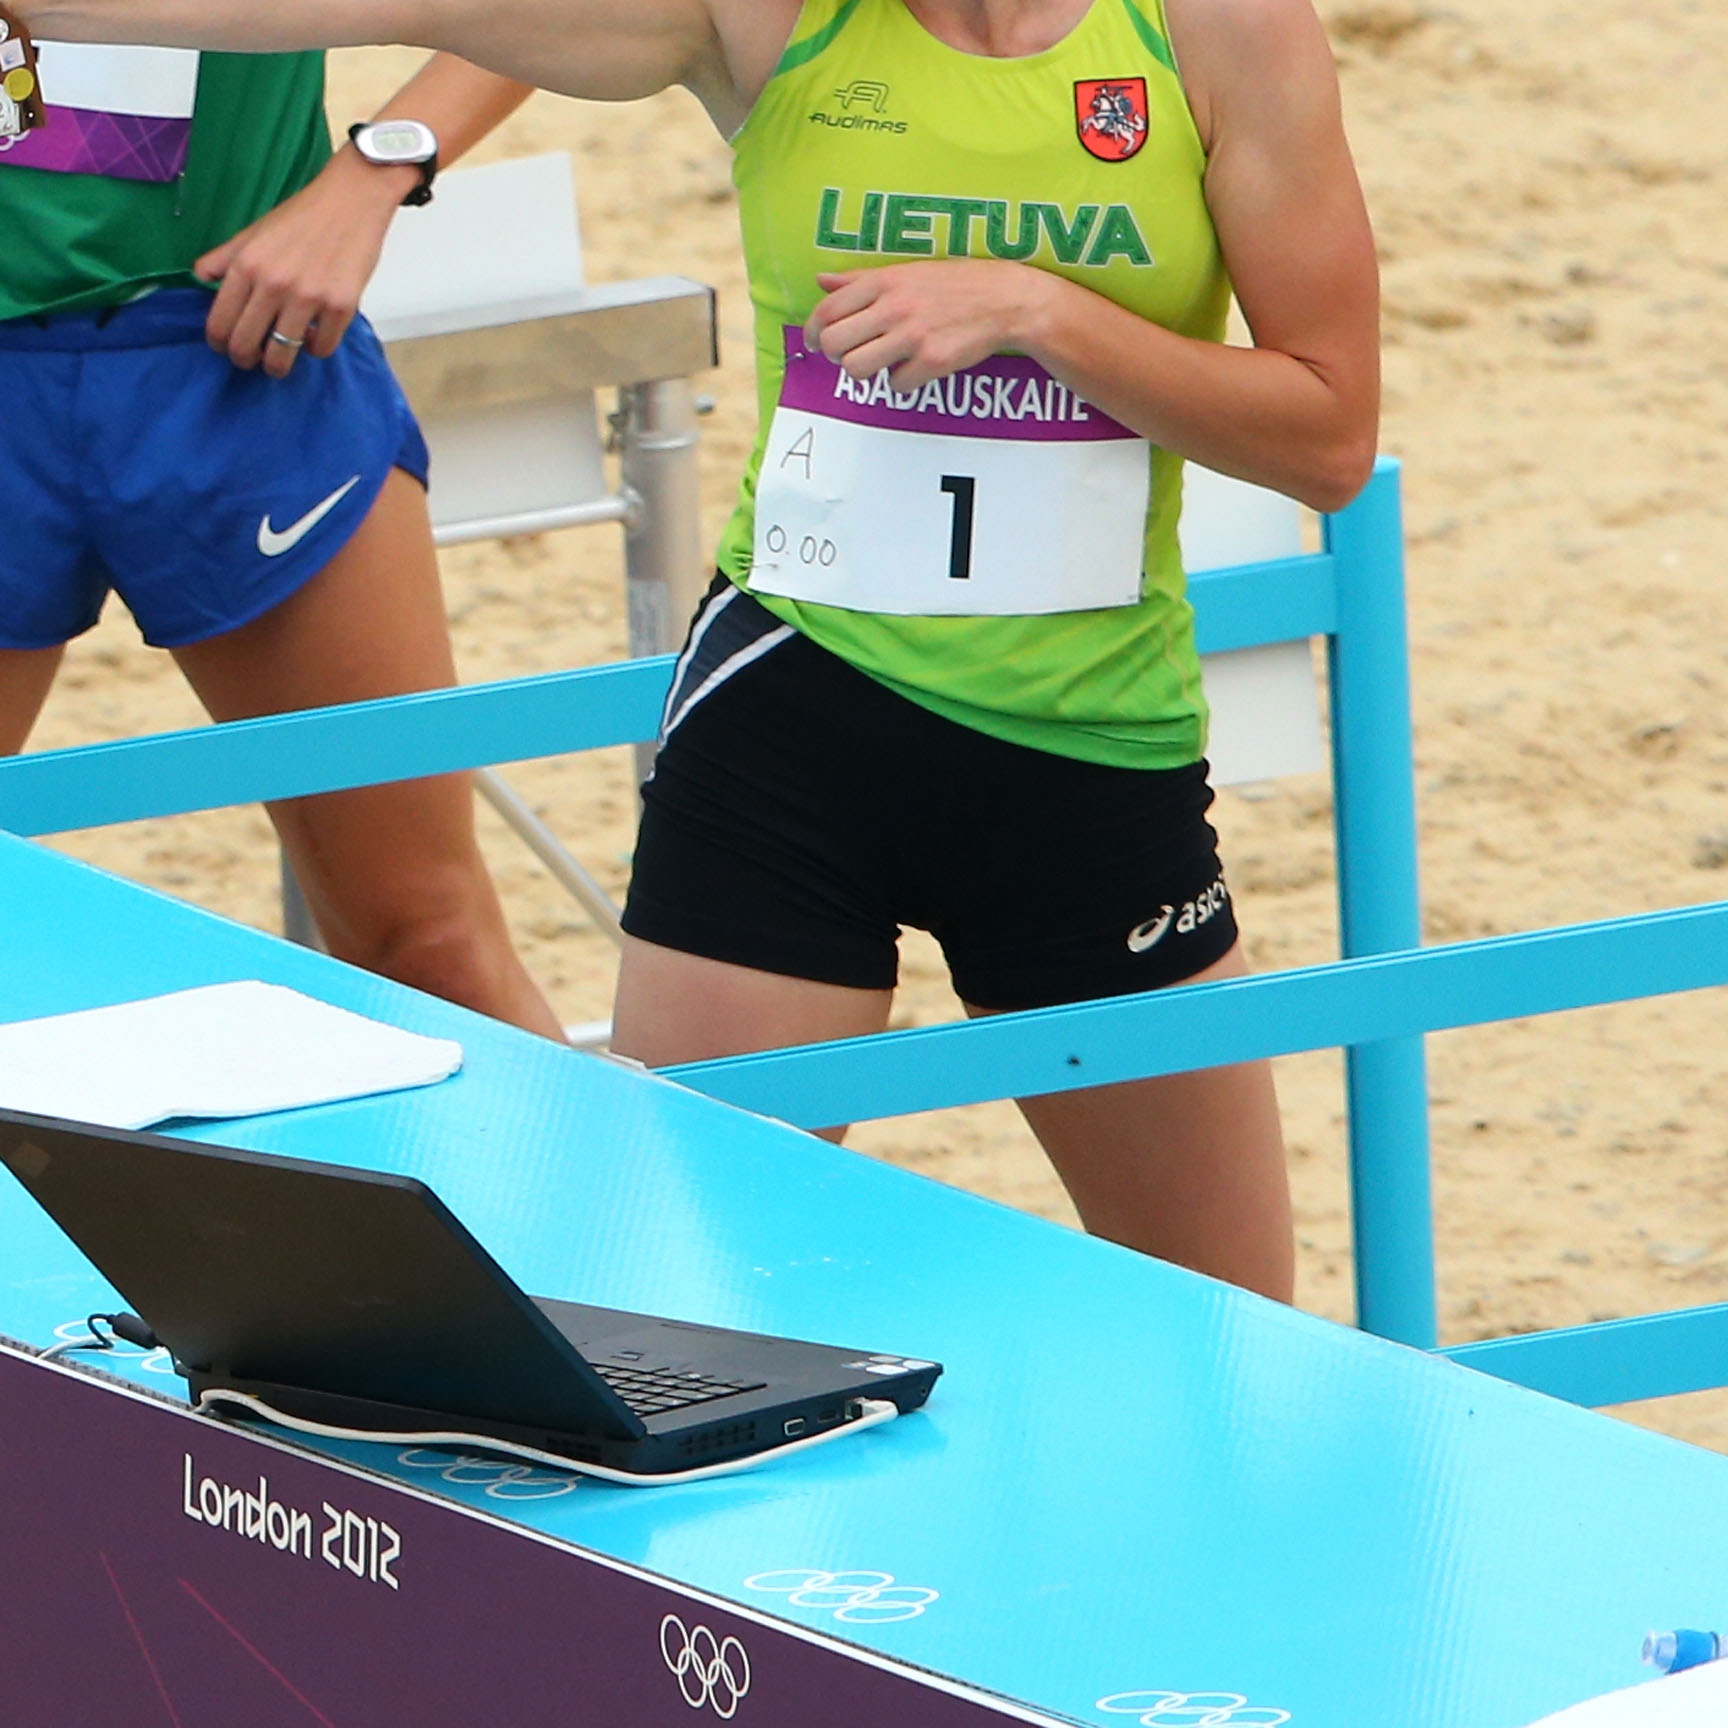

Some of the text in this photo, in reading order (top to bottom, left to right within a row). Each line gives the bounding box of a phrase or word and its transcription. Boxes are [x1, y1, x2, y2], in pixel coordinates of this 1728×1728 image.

[816, 187, 1155, 267] LIETUVA
[781, 427, 814, 479] A
[940, 474, 976, 580] 1
[1176, 873, 1225, 933] asic
[184, 1452, 401, 1591] London 2012
